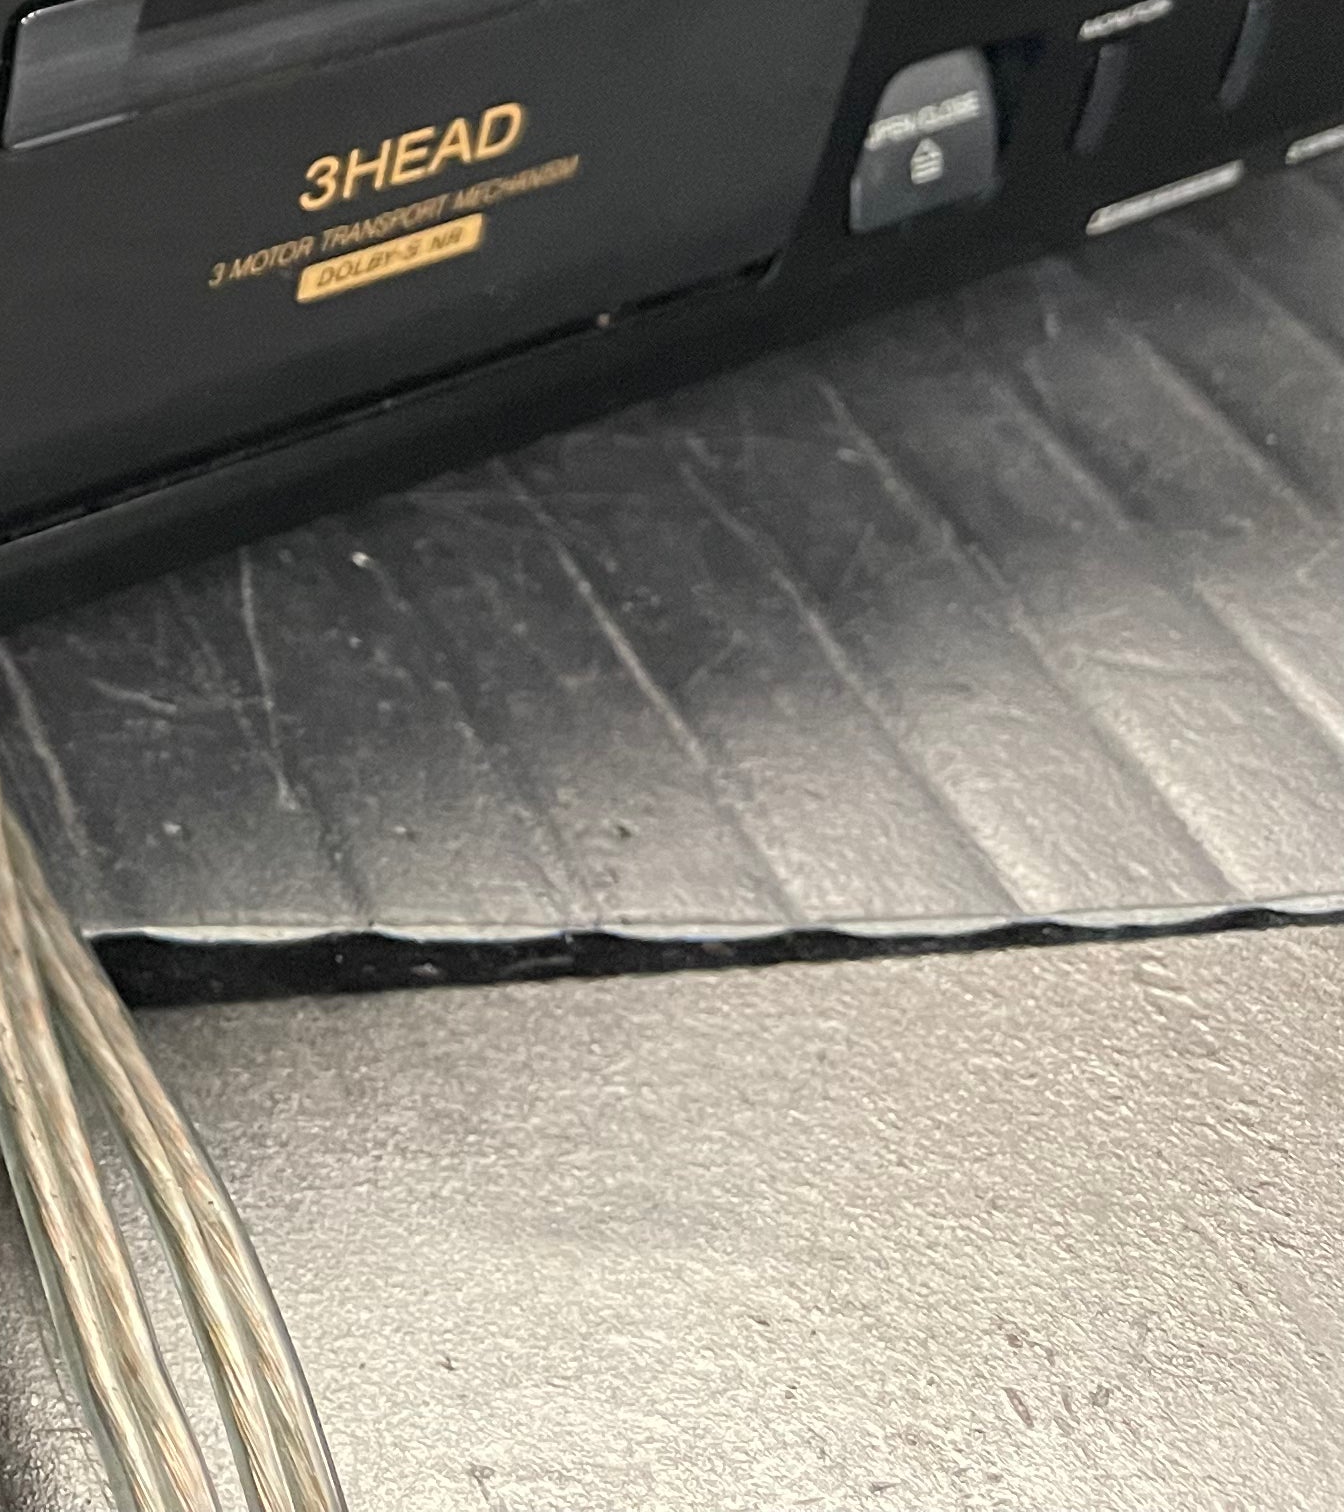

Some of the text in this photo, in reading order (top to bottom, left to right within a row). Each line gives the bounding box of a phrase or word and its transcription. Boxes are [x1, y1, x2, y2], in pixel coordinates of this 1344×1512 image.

[298, 101, 526, 212] 3HEAD
[208, 262, 226, 287] 3
[228, 236, 314, 280] MOTOR
[321, 194, 449, 252] TRANSPORT
[316, 248, 398, 288] DOLBY
[428, 225, 465, 254] NR
